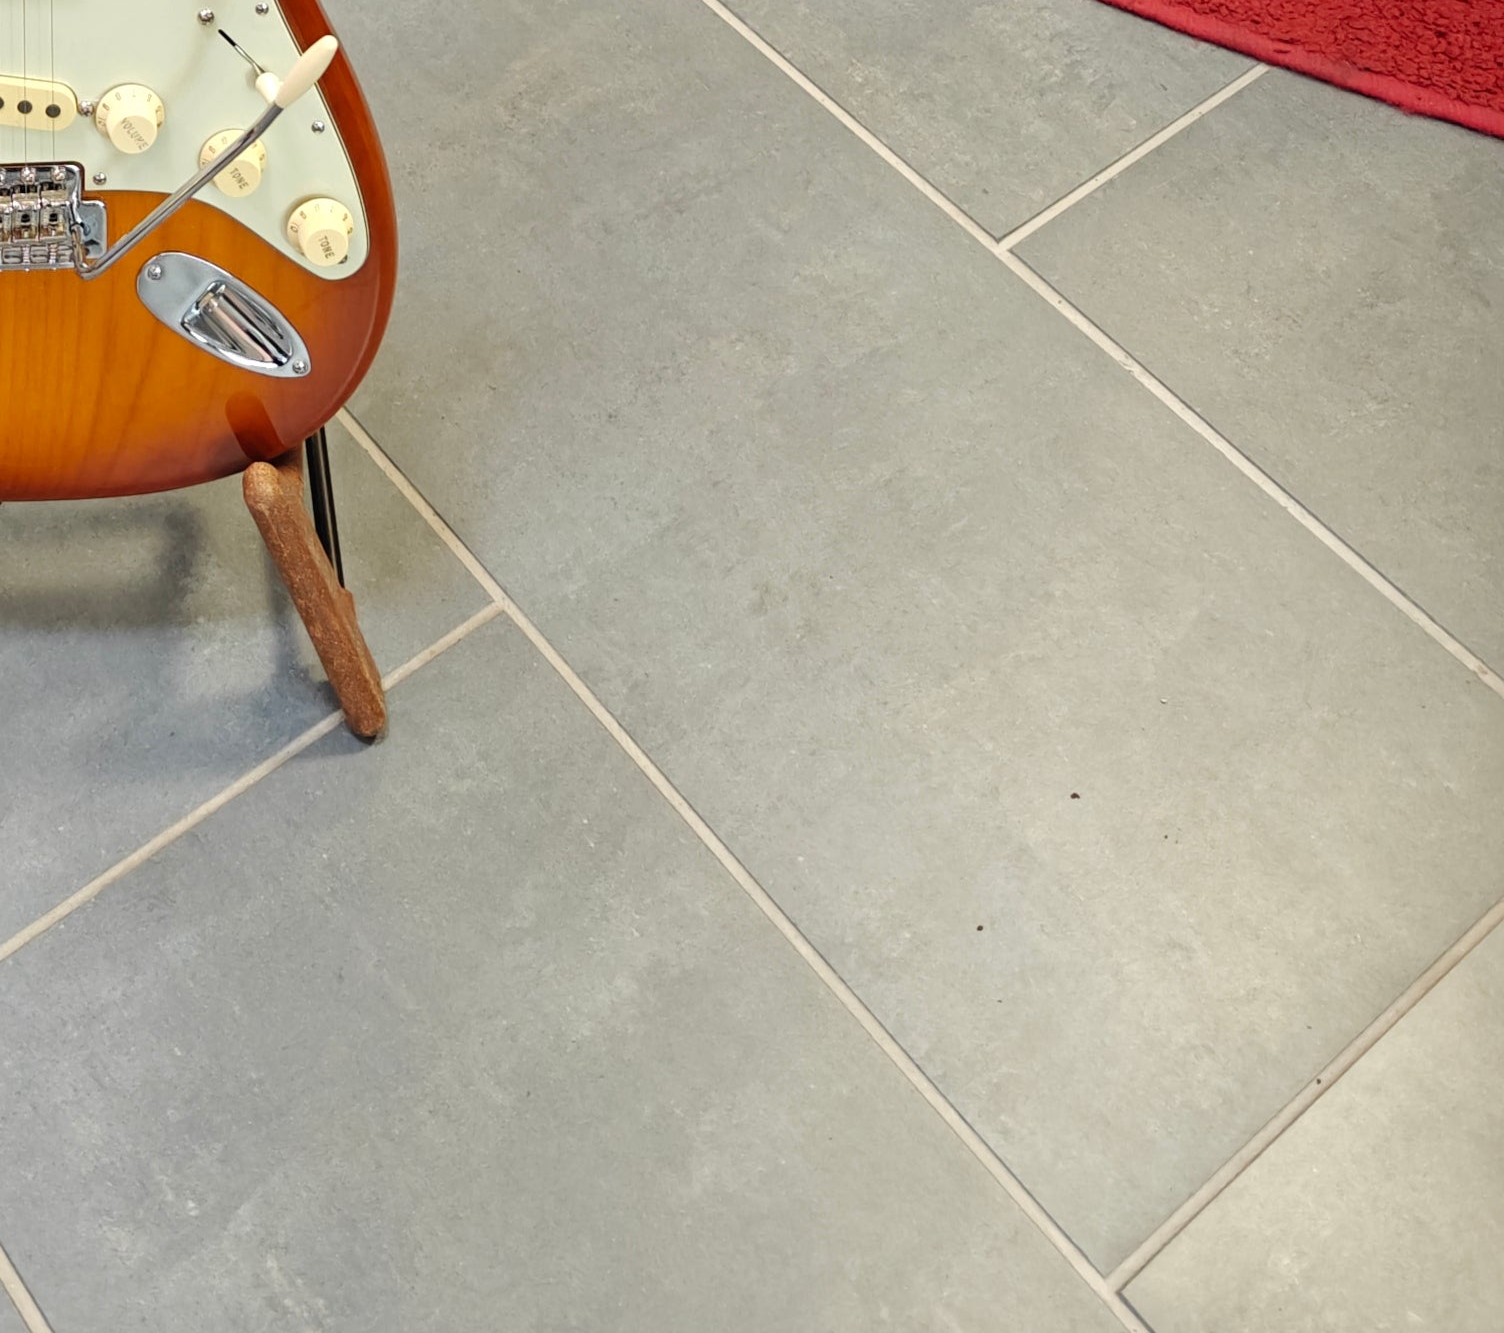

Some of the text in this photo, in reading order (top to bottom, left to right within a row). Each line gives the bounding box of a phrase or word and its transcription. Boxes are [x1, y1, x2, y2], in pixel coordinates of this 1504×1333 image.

[121, 117, 149, 150] VOLUME
[229, 166, 249, 190] TONE
[318, 235, 336, 259] TONE
